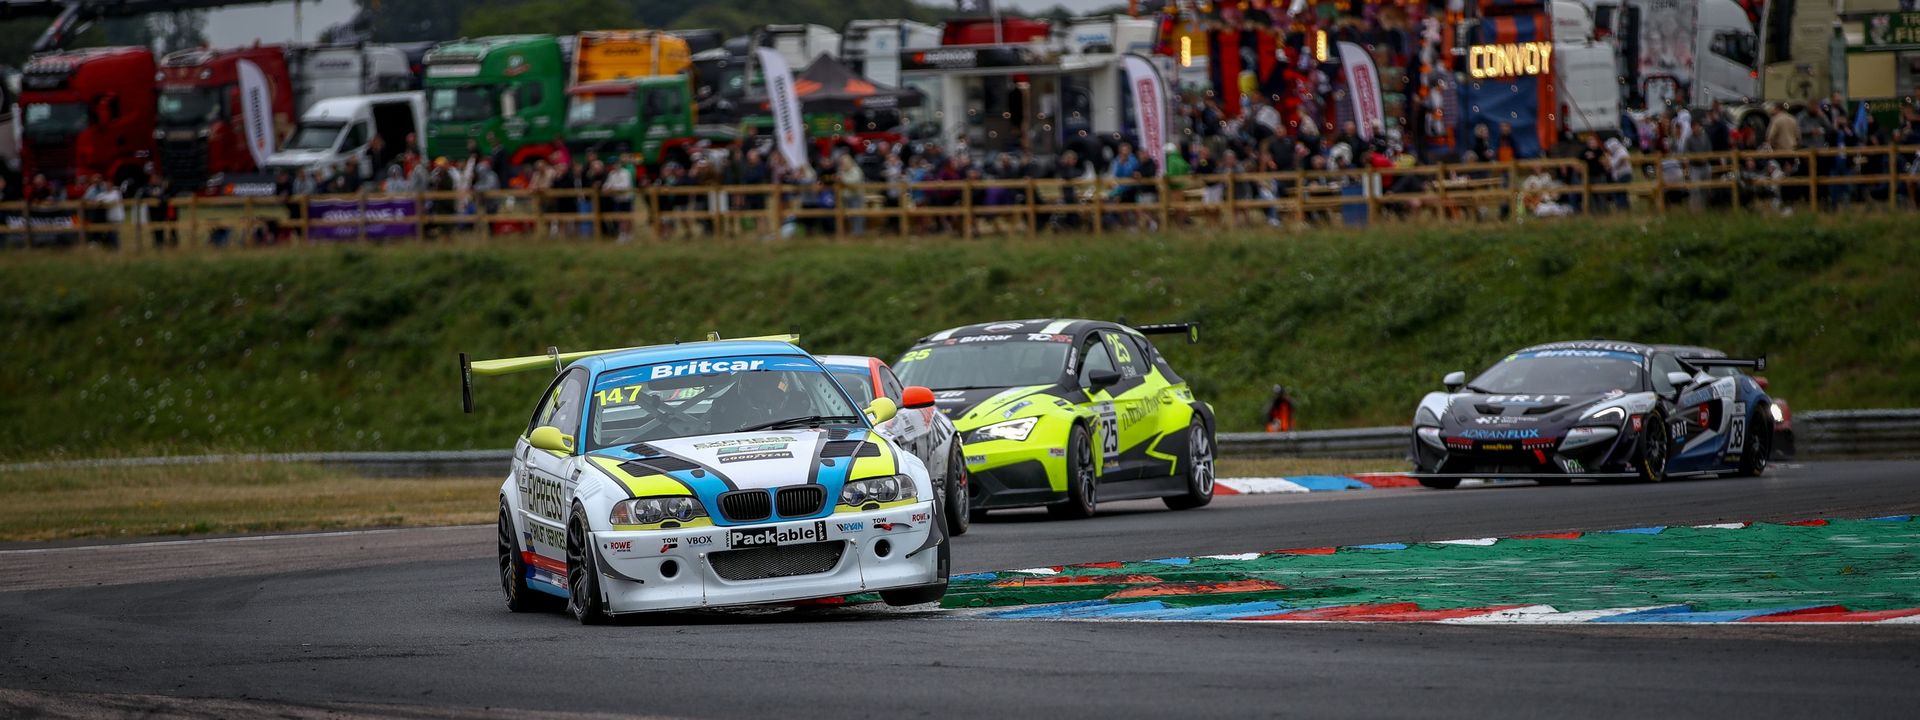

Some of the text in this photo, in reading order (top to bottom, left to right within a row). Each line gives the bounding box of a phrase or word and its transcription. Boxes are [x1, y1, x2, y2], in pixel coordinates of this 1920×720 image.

[1470, 41, 1552, 78] CONVOY
[959, 334, 1012, 344] Britcar
[901, 348, 932, 363] 25
[1106, 333, 1131, 364] 25
[1535, 350, 1611, 359] Britcar
[650, 360, 765, 380] Britcar
[594, 385, 643, 407] 147
[1486, 395, 1571, 404] BRIT
[1103, 419, 1118, 453] 25
[1671, 420, 1688, 440] BRIT
[1730, 420, 1744, 450] 38
[720, 452, 792, 462] GOODYEAR
[528, 473, 563, 521] EXPRESS
[844, 522, 864, 531] RYAN
[610, 541, 631, 550] ROWE
[686, 536, 713, 545] VBOX
[732, 528, 815, 546] Packable
